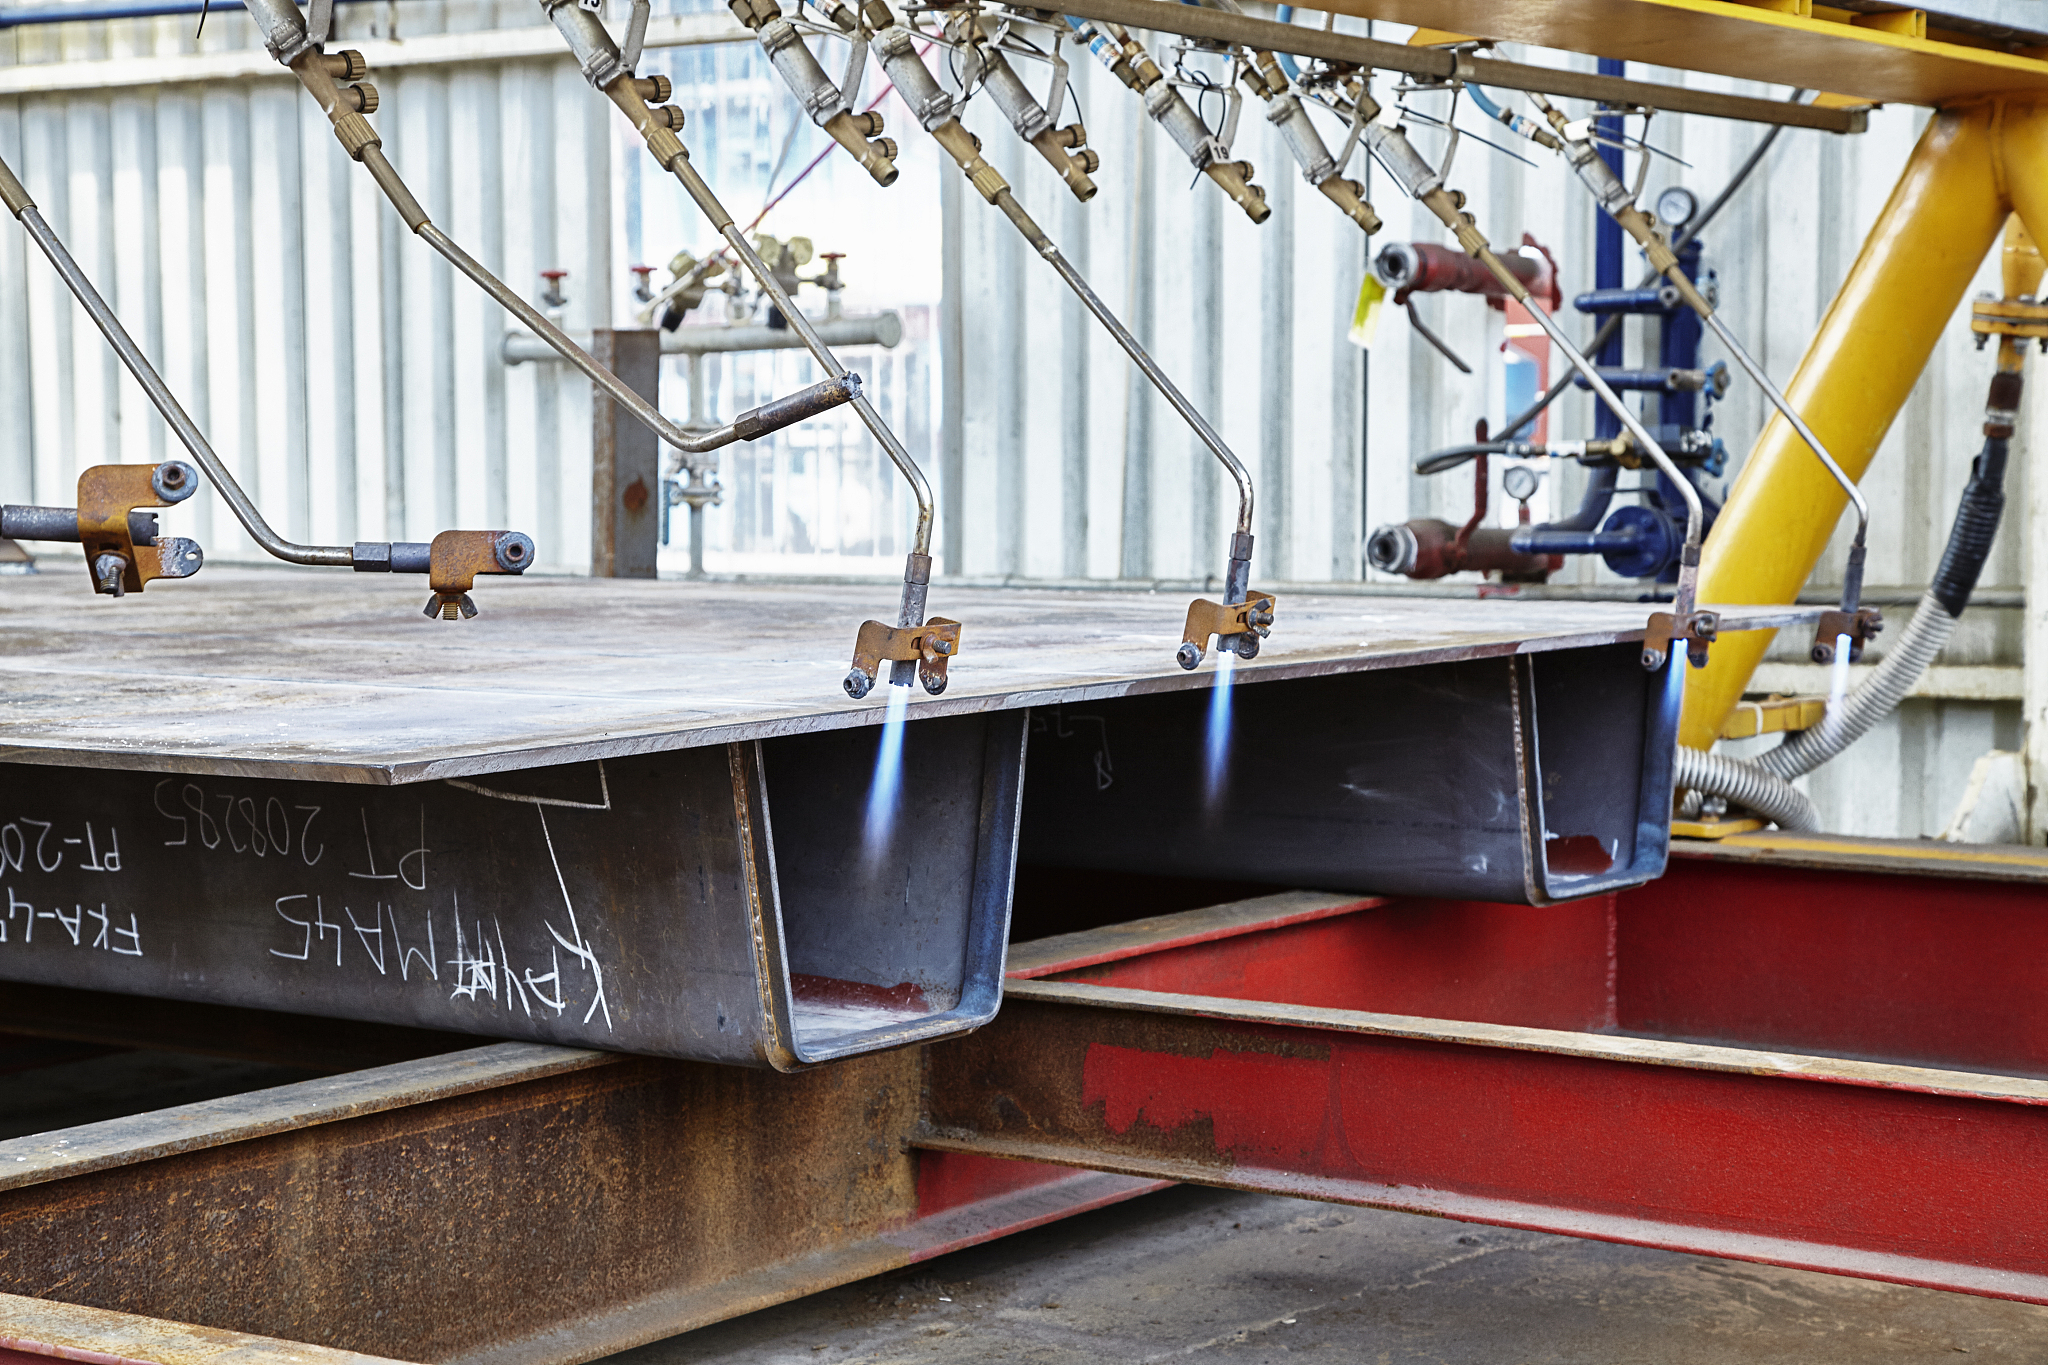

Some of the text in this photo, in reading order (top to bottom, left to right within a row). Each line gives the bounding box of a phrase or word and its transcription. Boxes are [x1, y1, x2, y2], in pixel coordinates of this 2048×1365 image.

[1213, 146, 1230, 160] 19
[0, 818, 122, 878] PT-20
[154, 778, 431, 890] PT 208285
